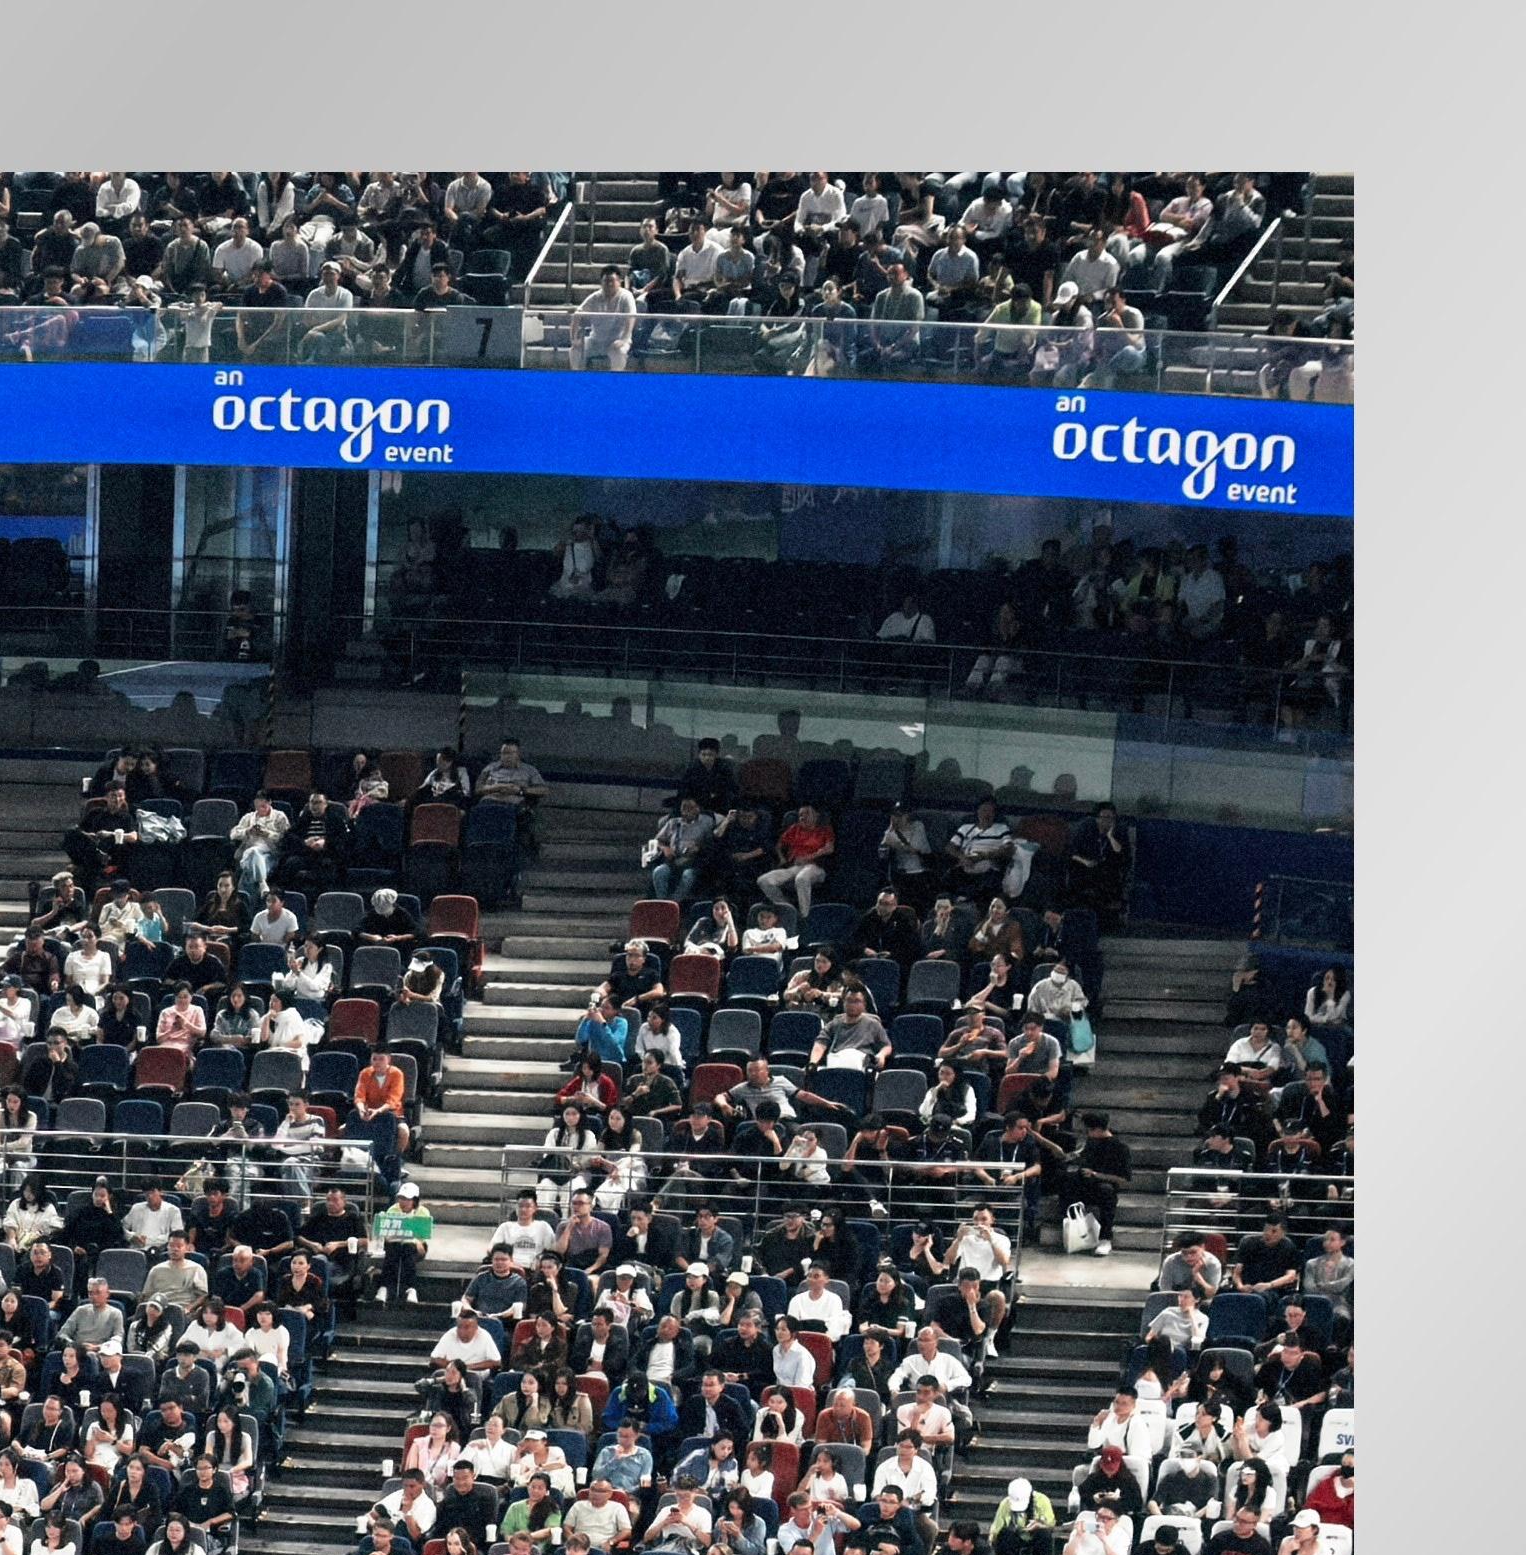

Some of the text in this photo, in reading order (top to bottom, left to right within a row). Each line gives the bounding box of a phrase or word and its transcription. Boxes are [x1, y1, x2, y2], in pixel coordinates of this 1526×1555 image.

[475, 318, 493, 358] 7
[214, 370, 243, 386] an
[1055, 396, 1086, 412] an
[212, 388, 450, 463] octagon
[385, 444, 454, 463] event
[1052, 416, 1296, 500] octagon
[1226, 482, 1298, 504] event
